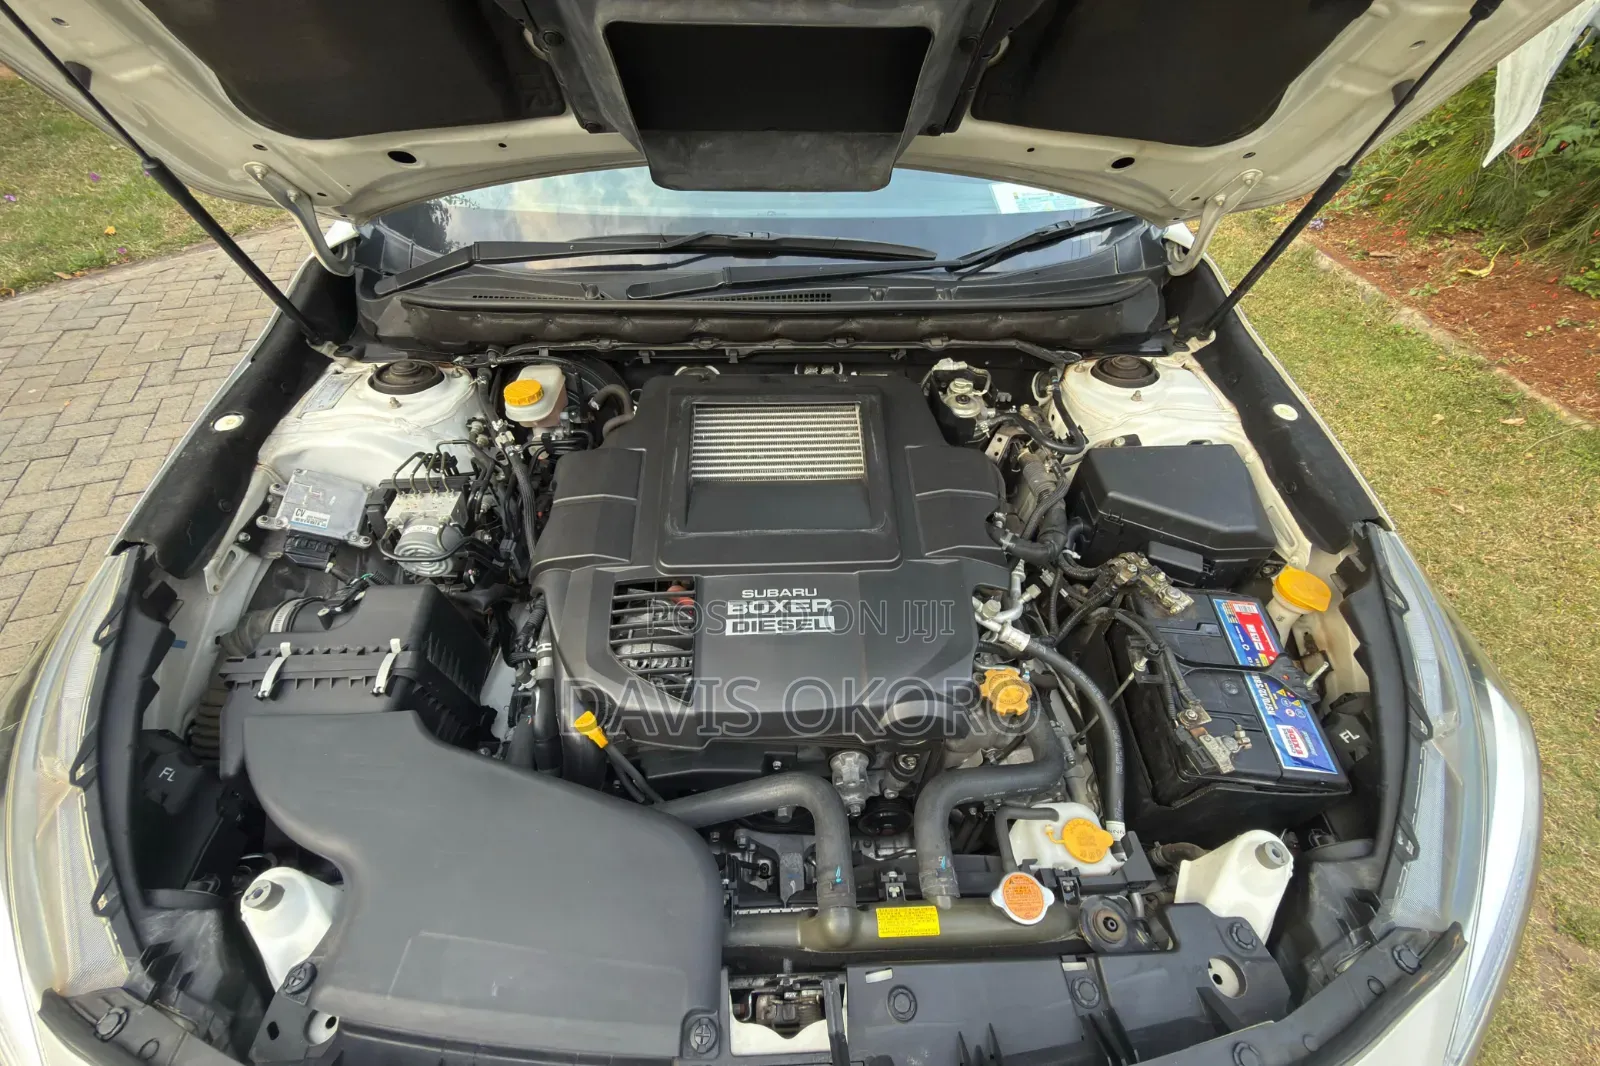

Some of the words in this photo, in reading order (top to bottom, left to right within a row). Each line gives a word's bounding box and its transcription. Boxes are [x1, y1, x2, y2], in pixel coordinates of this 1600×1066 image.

[296, 508, 306, 518] CV
[741, 588, 817, 598] SUBARU
[727, 599, 833, 615] BOXER
[729, 617, 832, 634] DIESEL
[1288, 729, 1304, 755] EXIDE
[1339, 729, 1360, 743] FL
[158, 766, 176, 782] FL
